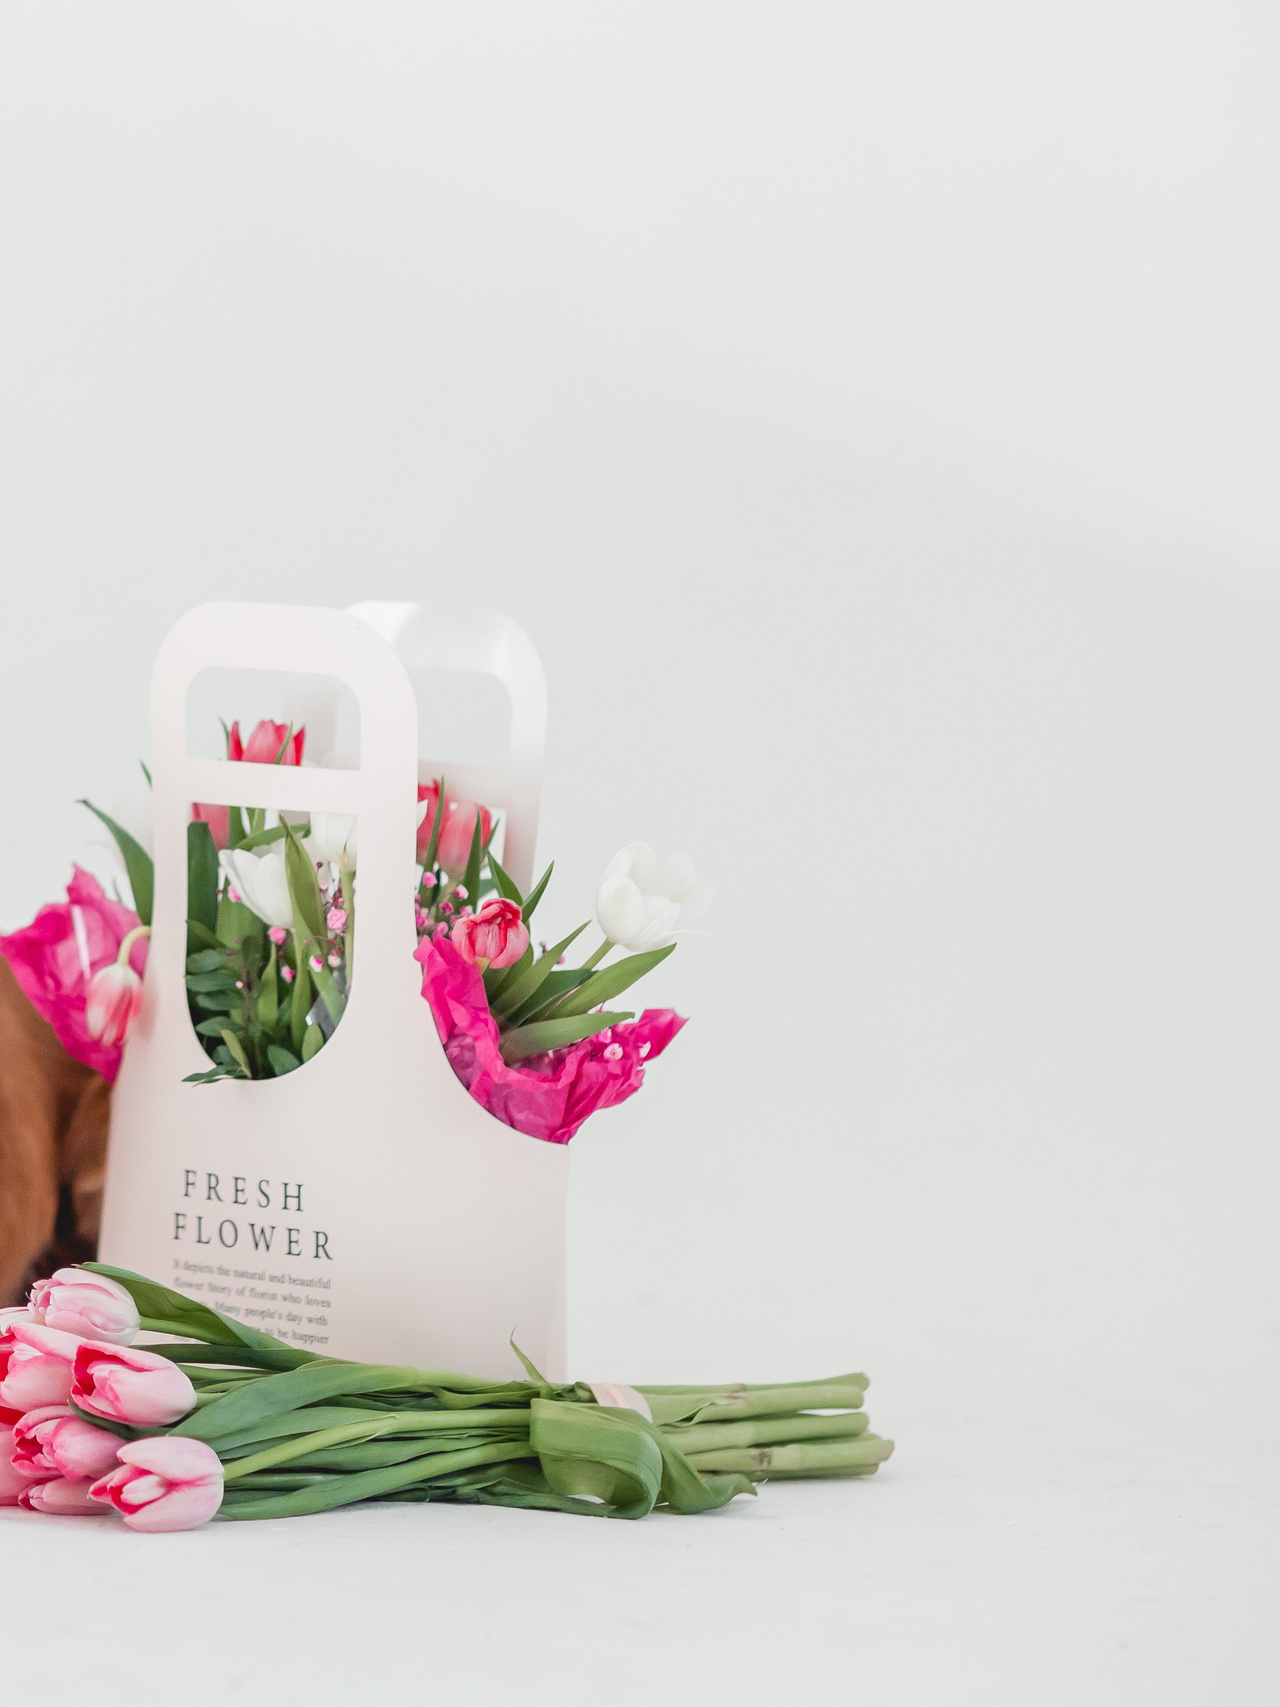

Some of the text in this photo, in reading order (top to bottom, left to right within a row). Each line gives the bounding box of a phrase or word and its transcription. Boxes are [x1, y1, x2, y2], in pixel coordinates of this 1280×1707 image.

[183, 1169, 305, 1212] FRESH
[173, 1212, 334, 1260] FLOWER
[183, 1262, 214, 1274] depicts
[217, 1265, 230, 1277] the
[234, 1269, 265, 1281] natural
[269, 1273, 285, 1284] and
[288, 1274, 331, 1289] beautiful
[235, 1286, 246, 1296] of
[249, 1287, 277, 1301] florist
[282, 1293, 302, 1304] who
[305, 1294, 331, 1308] loves
[244, 1307, 282, 1320] people's
[286, 1310, 303, 1325] day
[306, 1314, 328, 1327] with
[278, 1327, 289, 1338] be
[291, 1328, 329, 1345] happier
